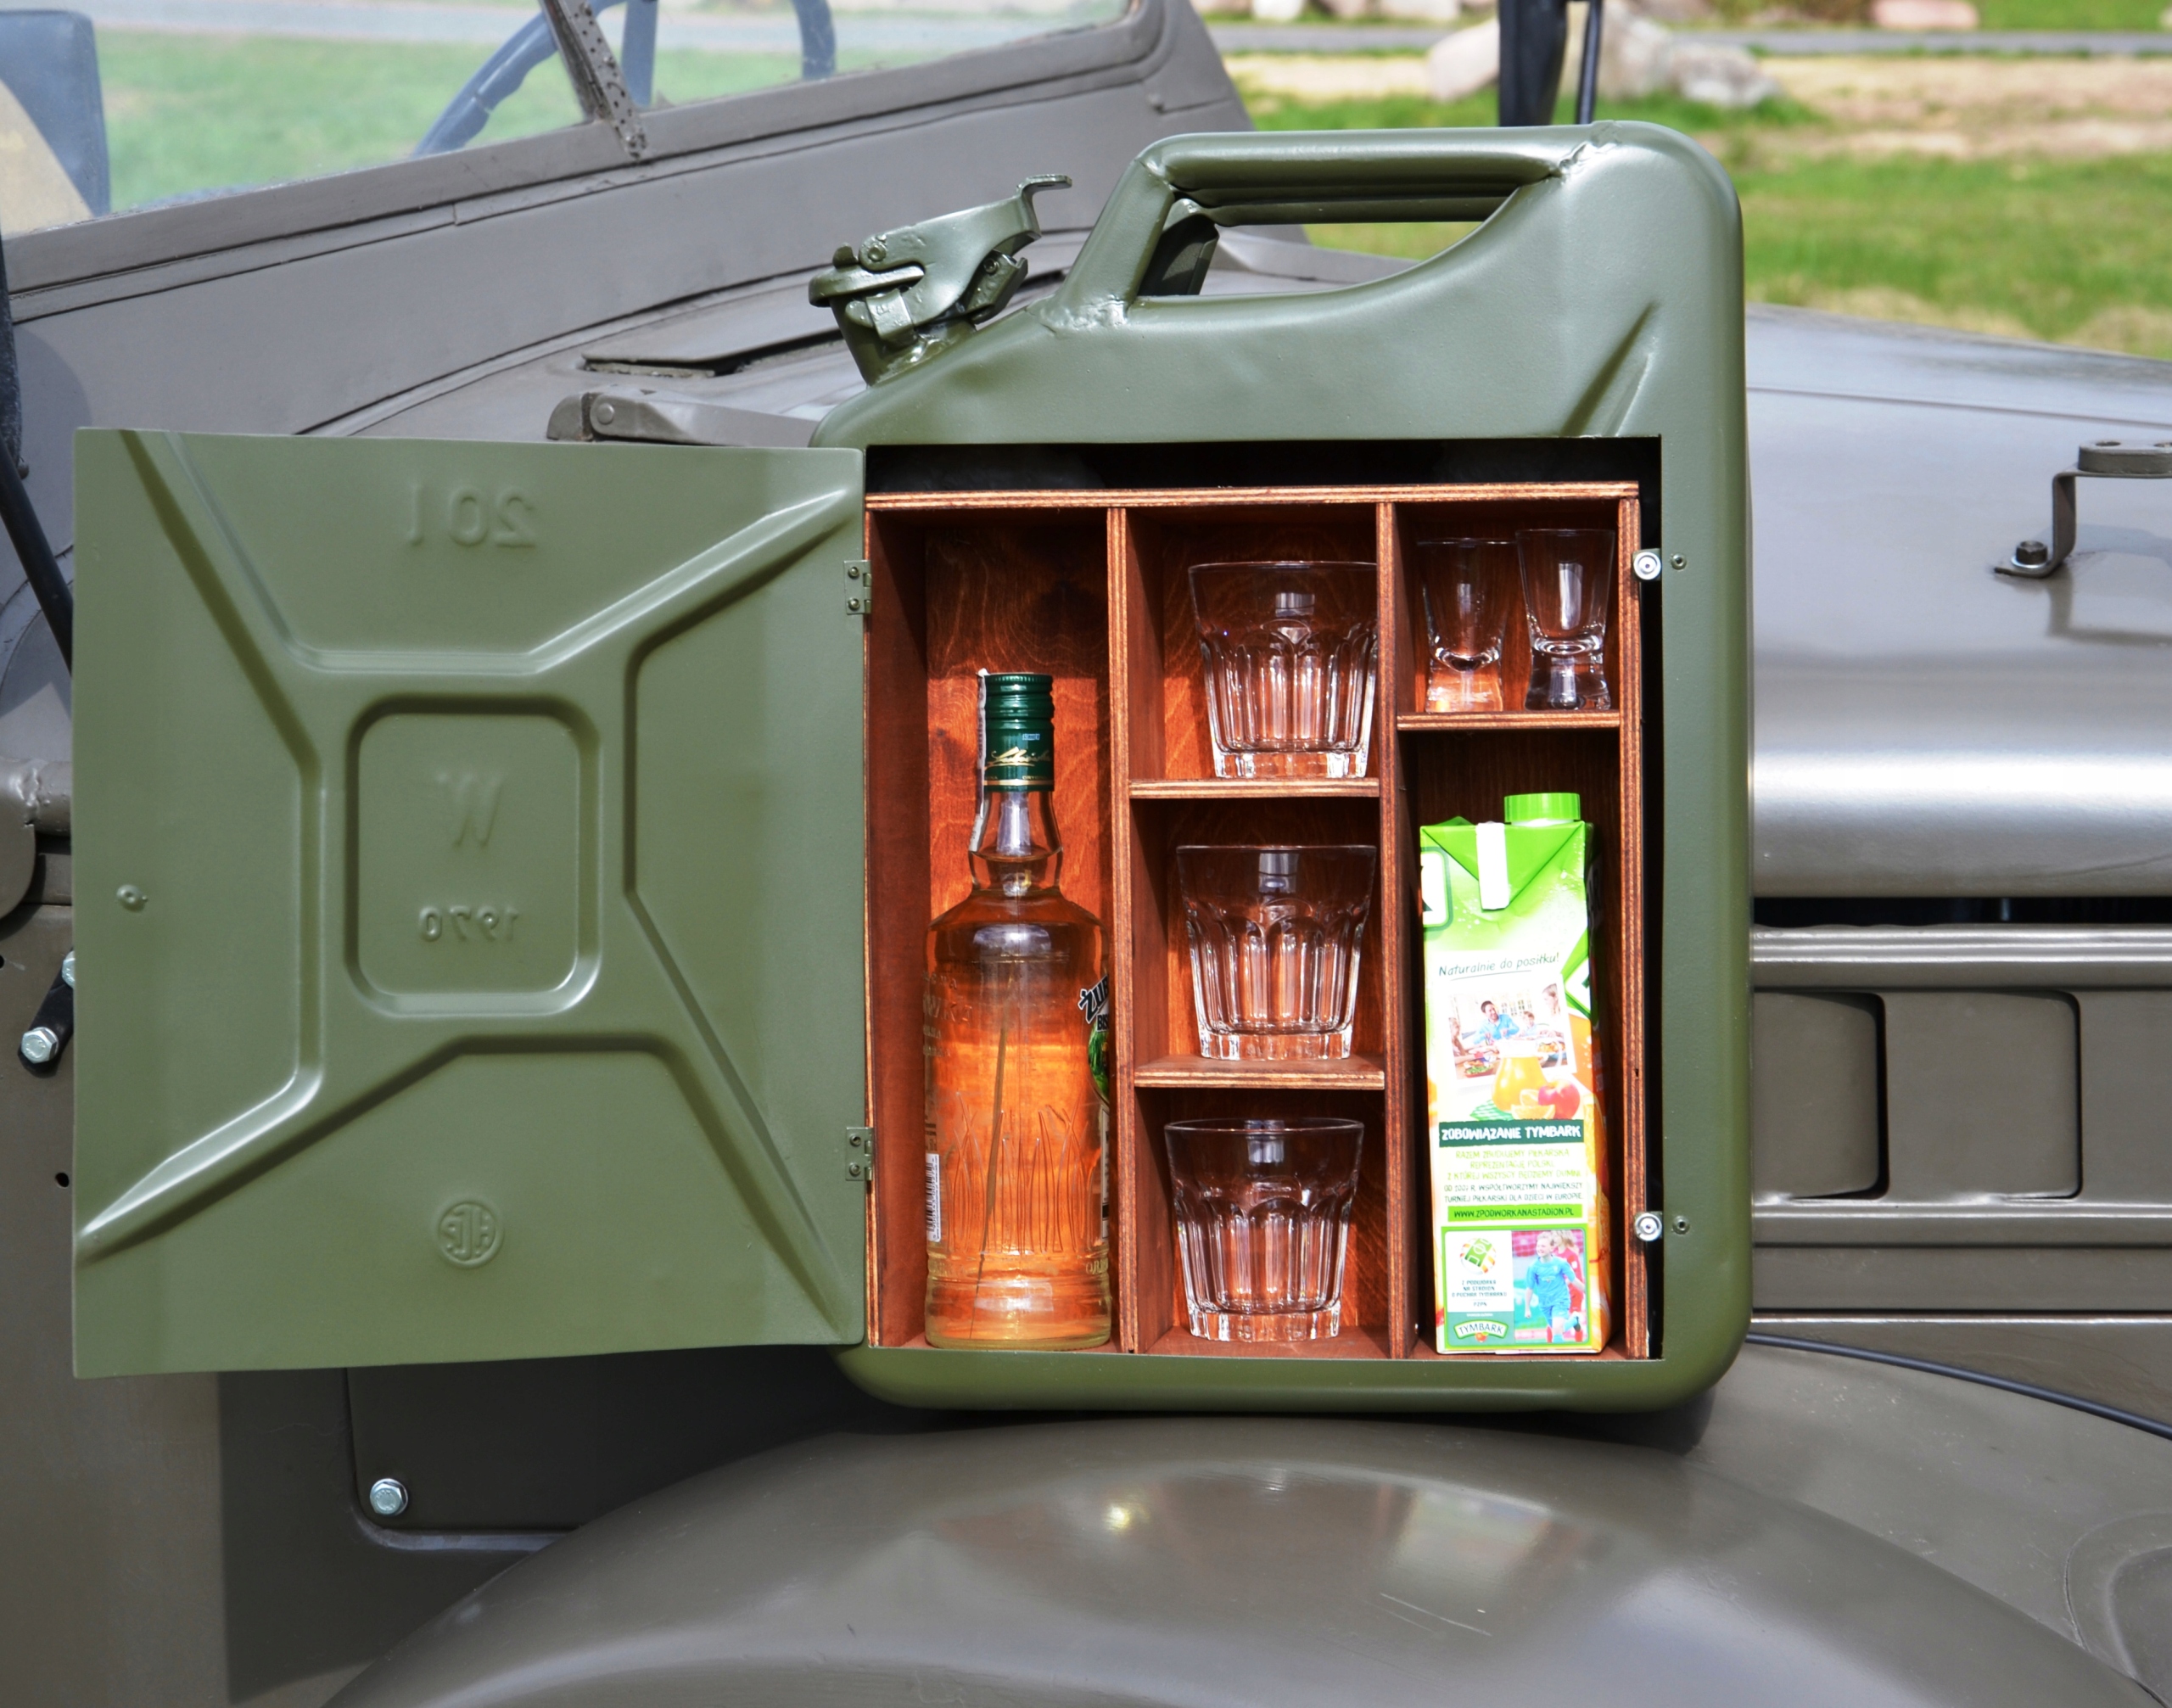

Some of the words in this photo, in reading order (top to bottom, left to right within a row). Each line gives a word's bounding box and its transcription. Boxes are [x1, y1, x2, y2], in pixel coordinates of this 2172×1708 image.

[1438, 960, 1496, 977] Naturalnie
[1499, 958, 1513, 970] do
[1516, 952, 1559, 970] posiłku!
[1441, 1127, 1521, 1141] ZOBOWIĄZANIE
[1525, 1125, 1581, 1139] TYMBARK
[1458, 1323, 1503, 1336] TYMBARK
